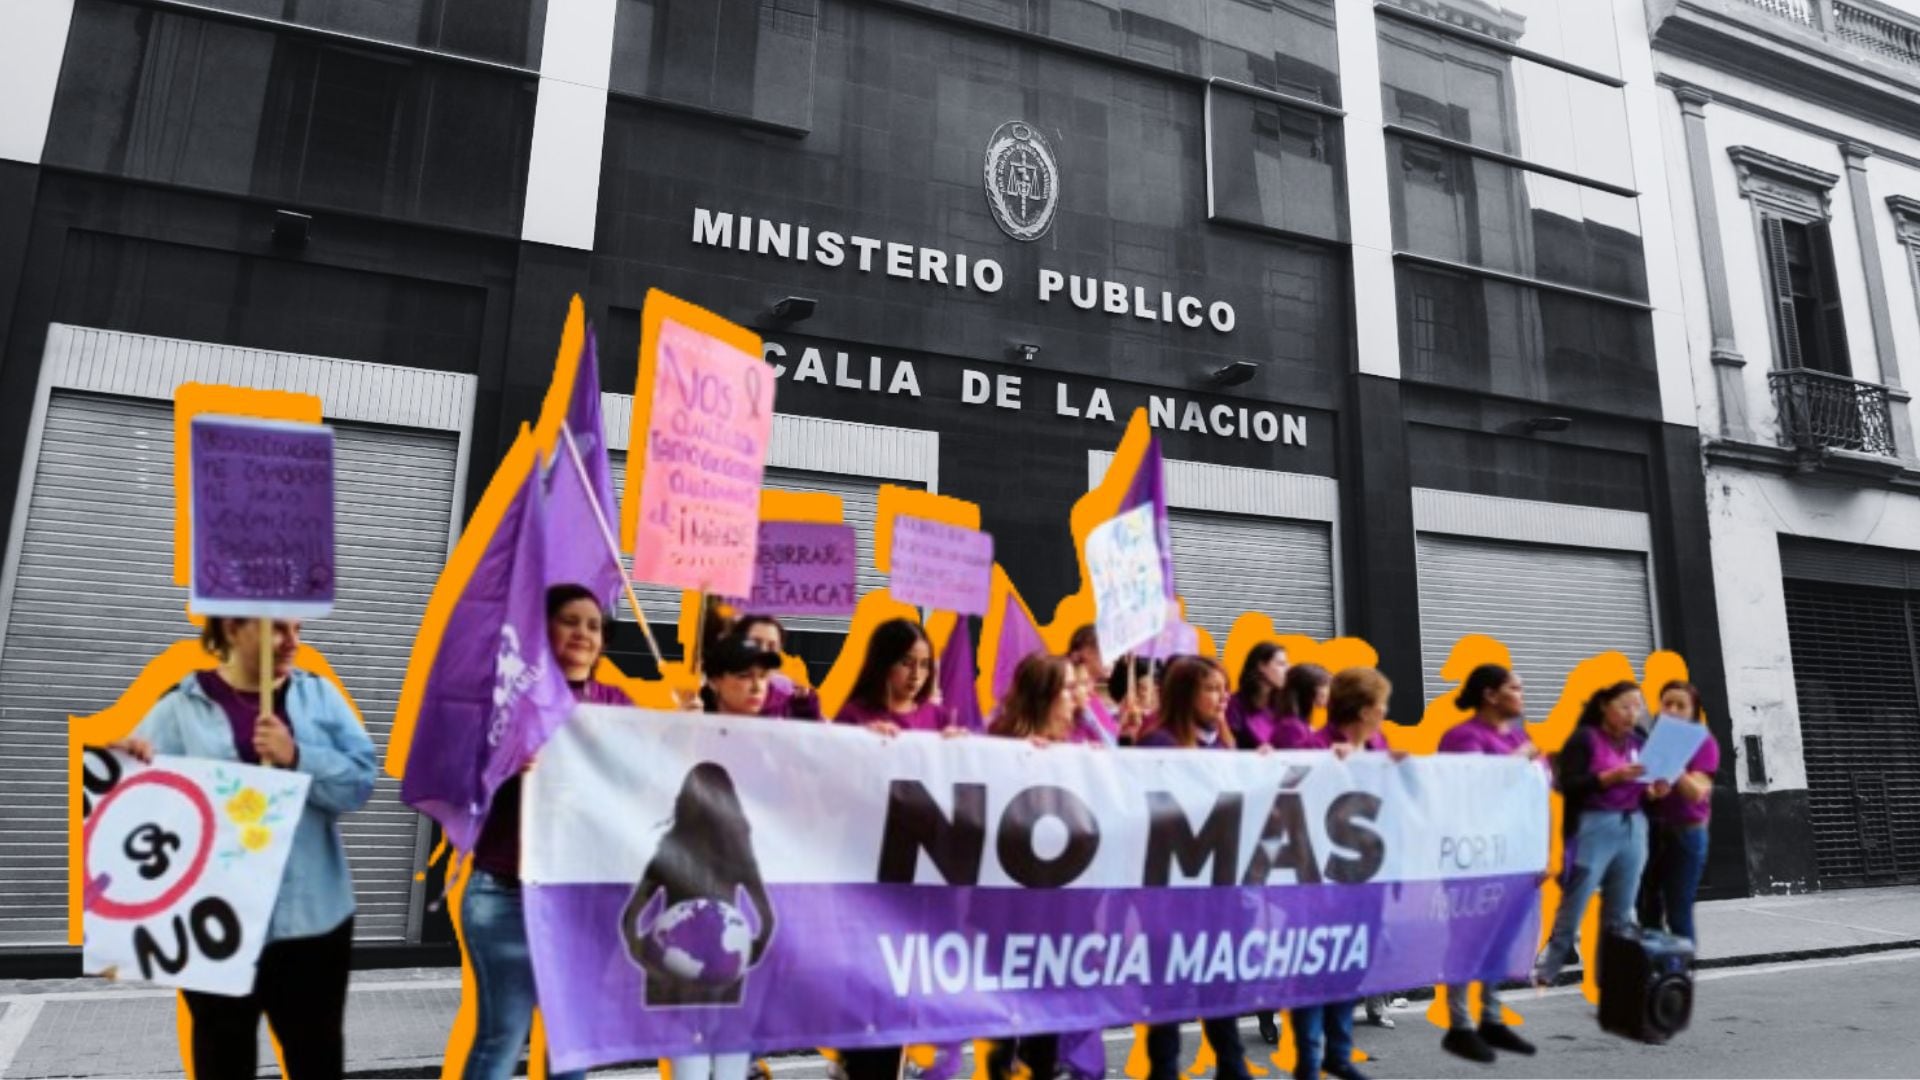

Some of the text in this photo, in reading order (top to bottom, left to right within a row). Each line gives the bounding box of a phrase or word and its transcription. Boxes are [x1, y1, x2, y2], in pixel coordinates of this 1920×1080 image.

[692, 207, 1237, 333] MINISTERIO PUBLICO
[663, 344, 732, 420] NOS
[763, 341, 1309, 447] CALIA DE LA NACION
[877, 766, 1386, 889] NO MÁS
[1438, 834, 1487, 870] POR
[134, 896, 242, 980] NO
[878, 924, 1369, 997] VIOLENCIA MACHISTA
